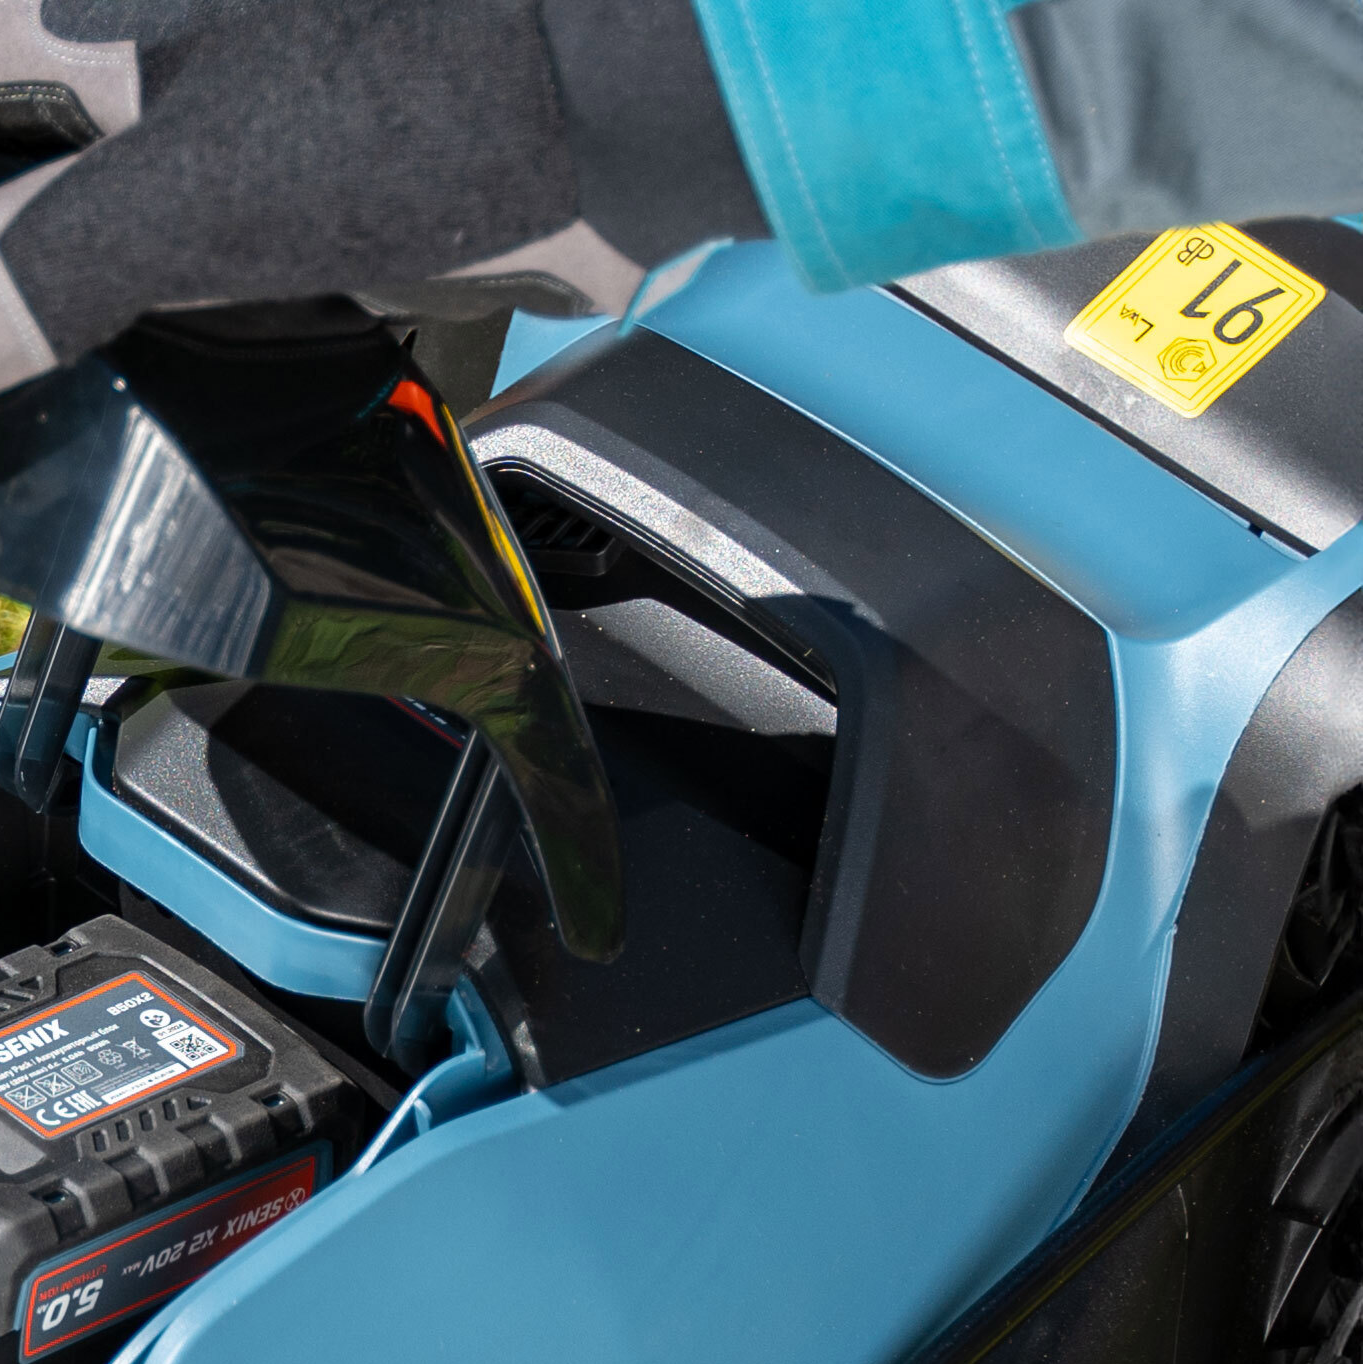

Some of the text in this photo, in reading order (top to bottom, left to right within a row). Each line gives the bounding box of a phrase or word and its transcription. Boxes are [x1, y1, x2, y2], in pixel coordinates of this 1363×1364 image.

[1177, 238, 1214, 266] dB
[1180, 259, 1285, 344] 91
[106, 991, 155, 1015] B50X2
[10, 1061, 33, 1073] Pack
[222, 1197, 283, 1240] SENIX
[188, 1226, 219, 1254] X2
[42, 1279, 104, 1331] 5.0
